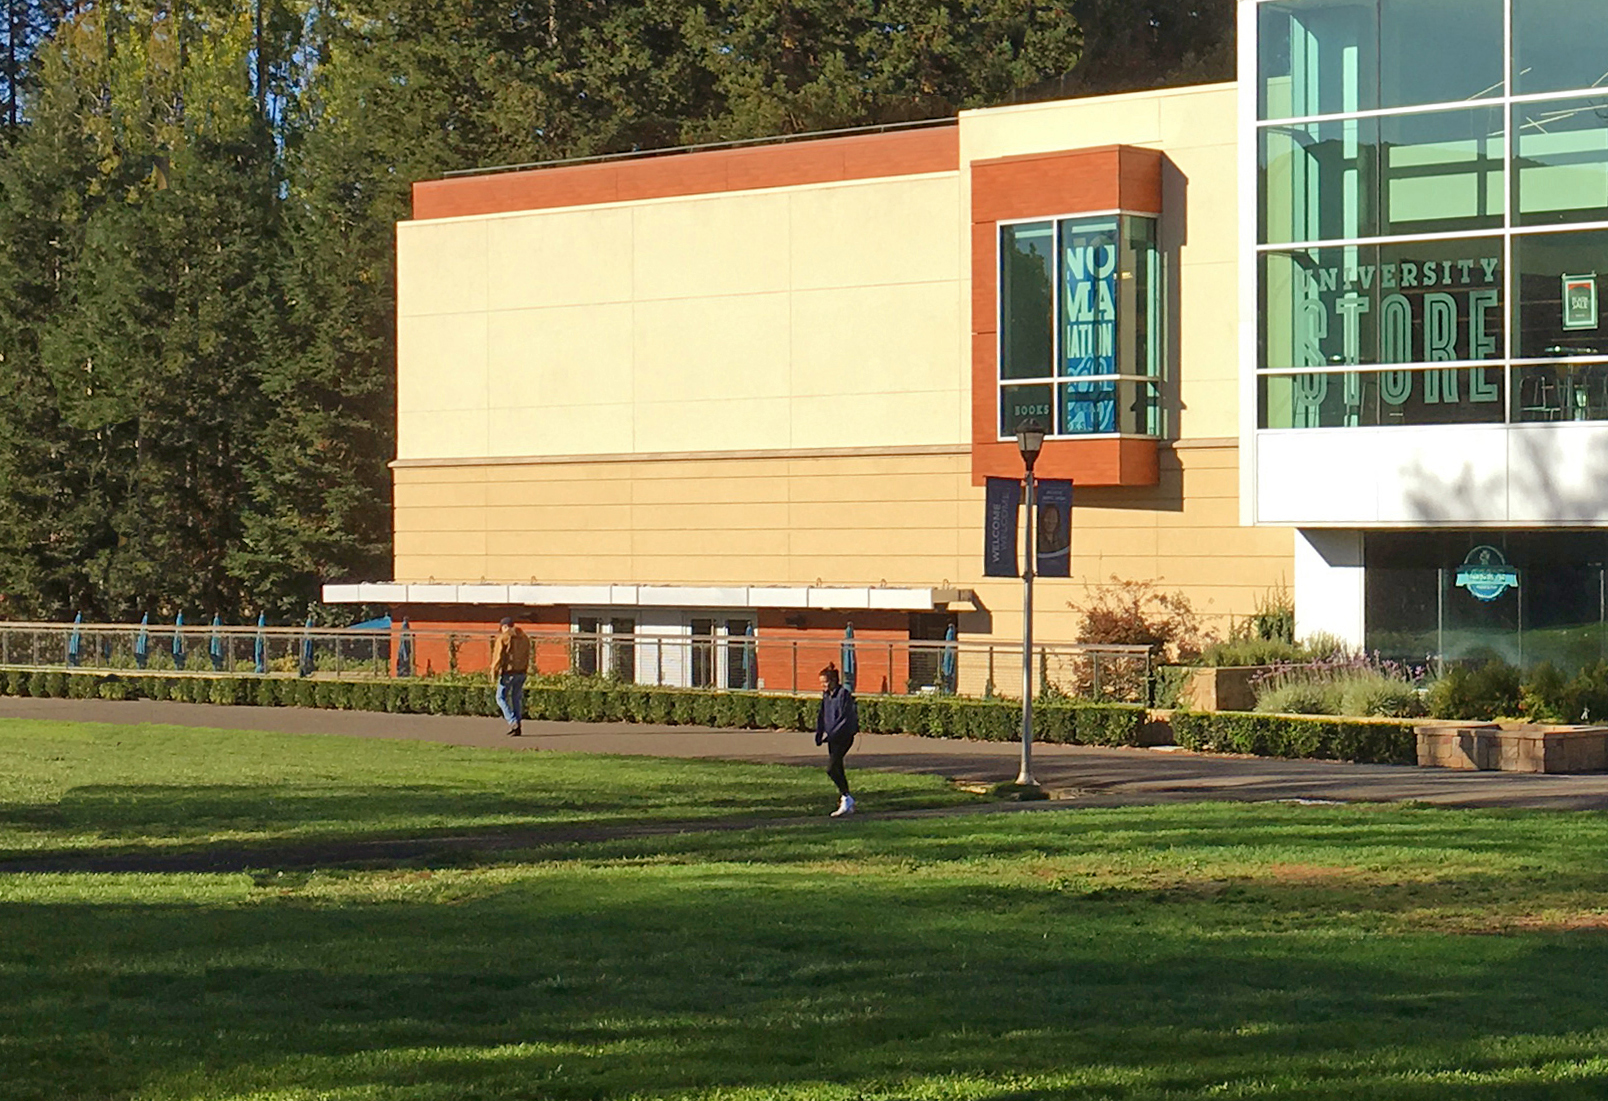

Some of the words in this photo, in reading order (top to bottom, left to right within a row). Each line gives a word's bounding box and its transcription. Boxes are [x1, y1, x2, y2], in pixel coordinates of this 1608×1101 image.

[1302, 258, 1498, 292] UNIVERSITY
[1300, 289, 1498, 406] STORE
[1014, 404, 1050, 416] BOOKS
[991, 503, 1001, 563] WELCOME
